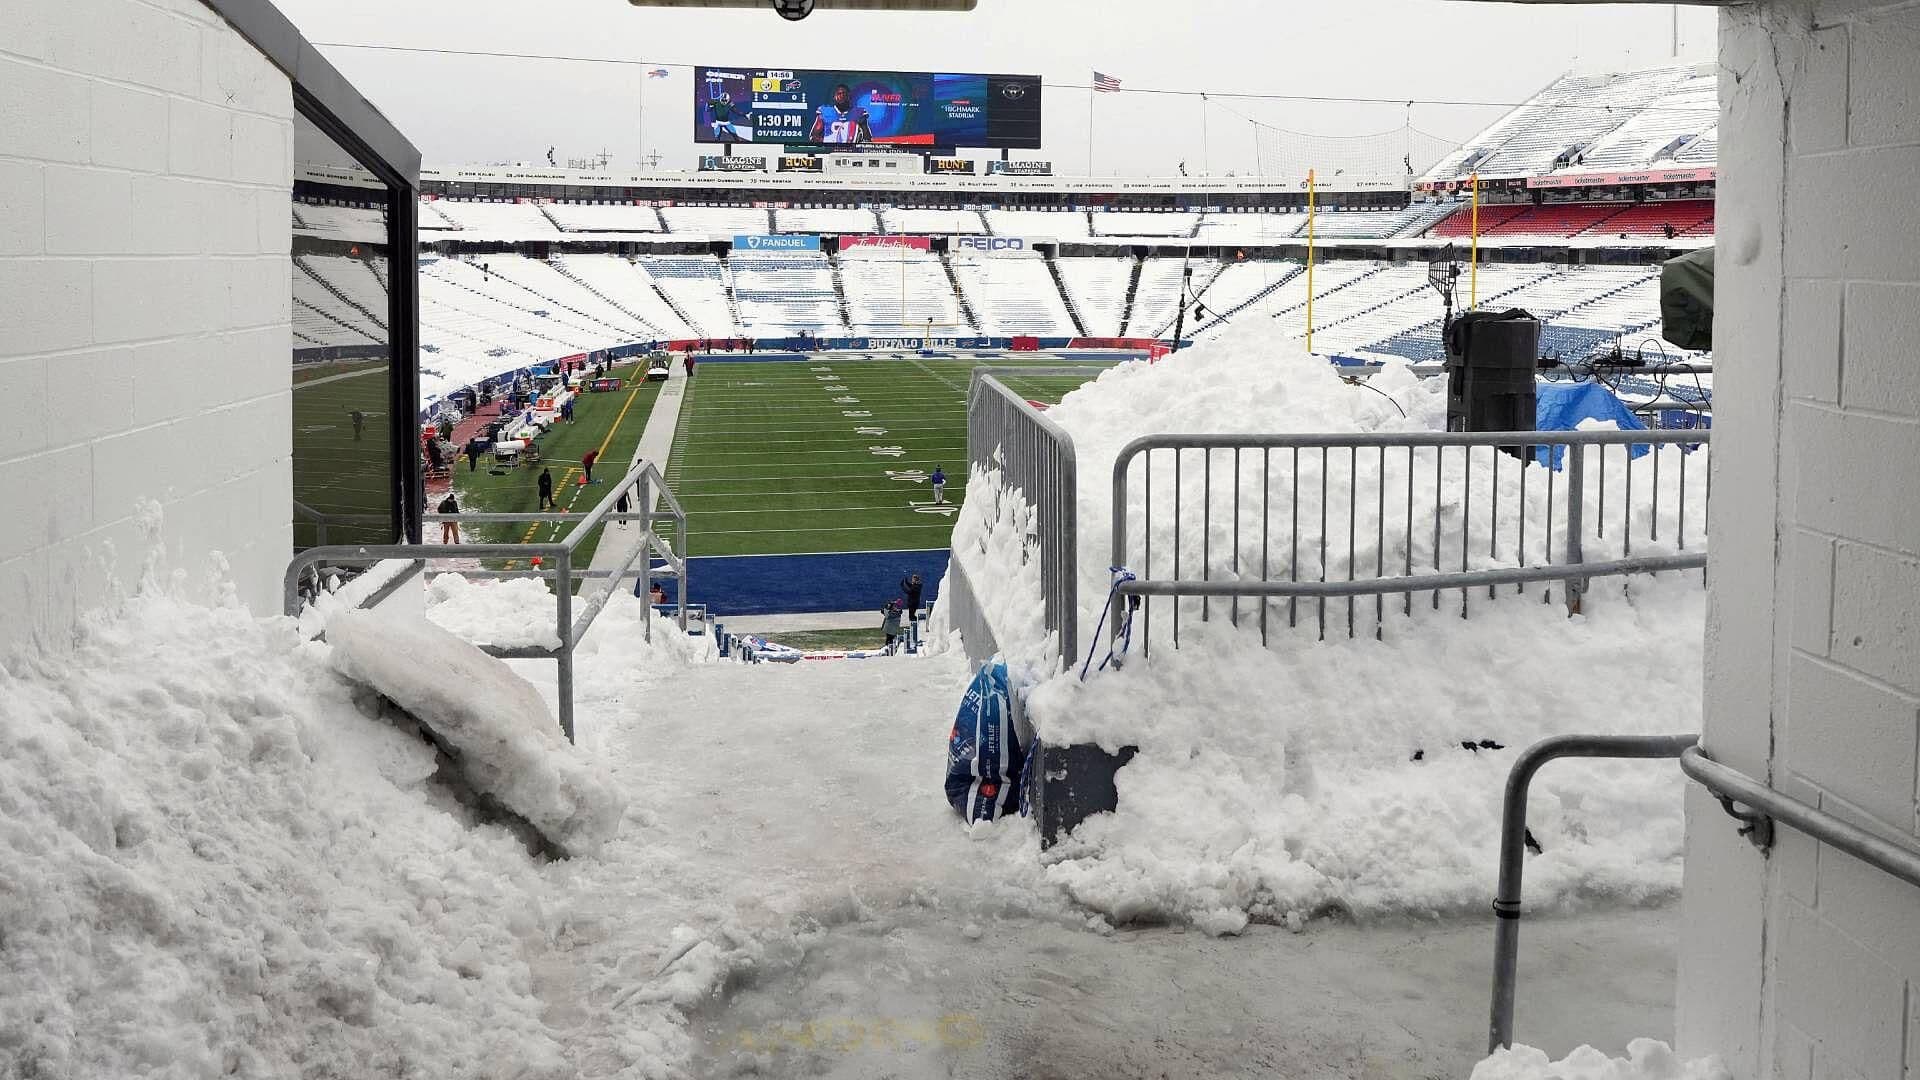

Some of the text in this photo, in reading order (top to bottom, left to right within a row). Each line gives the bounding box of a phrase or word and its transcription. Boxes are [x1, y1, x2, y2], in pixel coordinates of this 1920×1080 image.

[758, 115, 802, 126] 1:30 PM
[722, 156, 762, 164] IMAGINE
[785, 158, 815, 167] HUNT
[938, 160, 966, 169] HUNT
[1618, 175, 1650, 184] ticketmaster
[1664, 172, 1696, 181] ticketmaster
[762, 239, 806, 248] FANDUEL
[958, 238, 1024, 250] GEICO
[868, 338, 956, 349] BUFFALO BILLS
